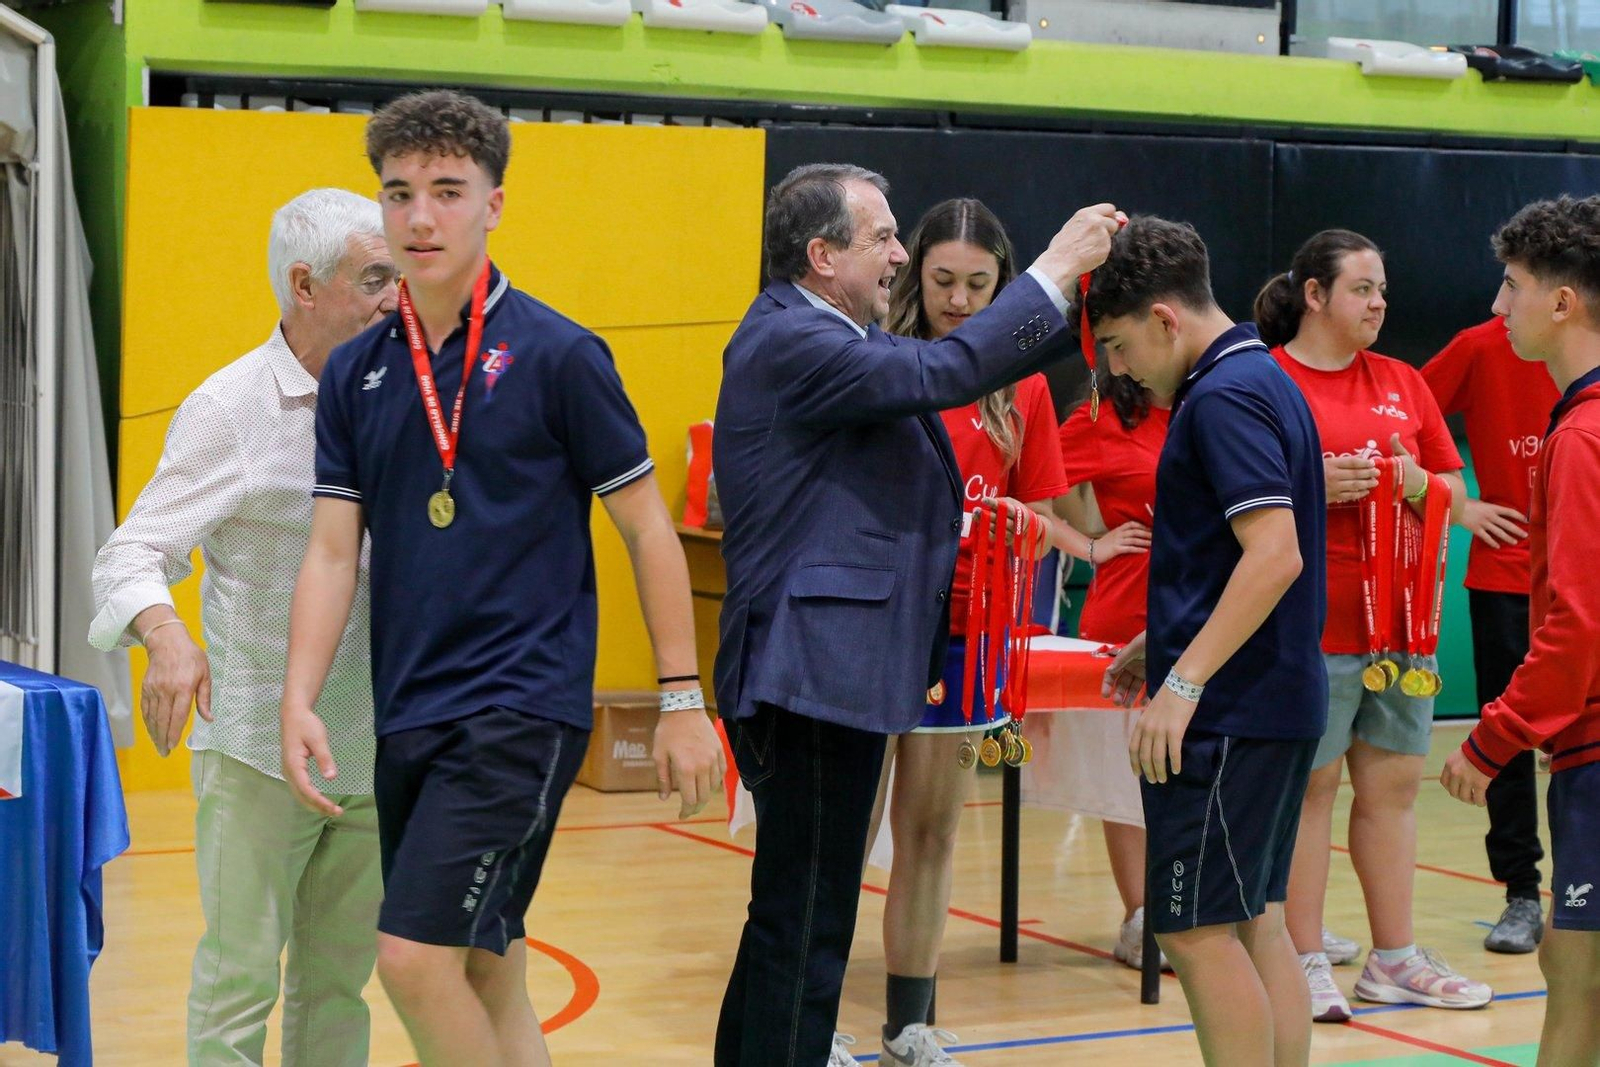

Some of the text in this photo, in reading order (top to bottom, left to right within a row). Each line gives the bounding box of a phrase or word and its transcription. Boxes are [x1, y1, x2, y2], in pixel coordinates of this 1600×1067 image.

[420, 374, 450, 450] CONCELLO DE VIGO
[1170, 860, 1185, 916] ZICO
